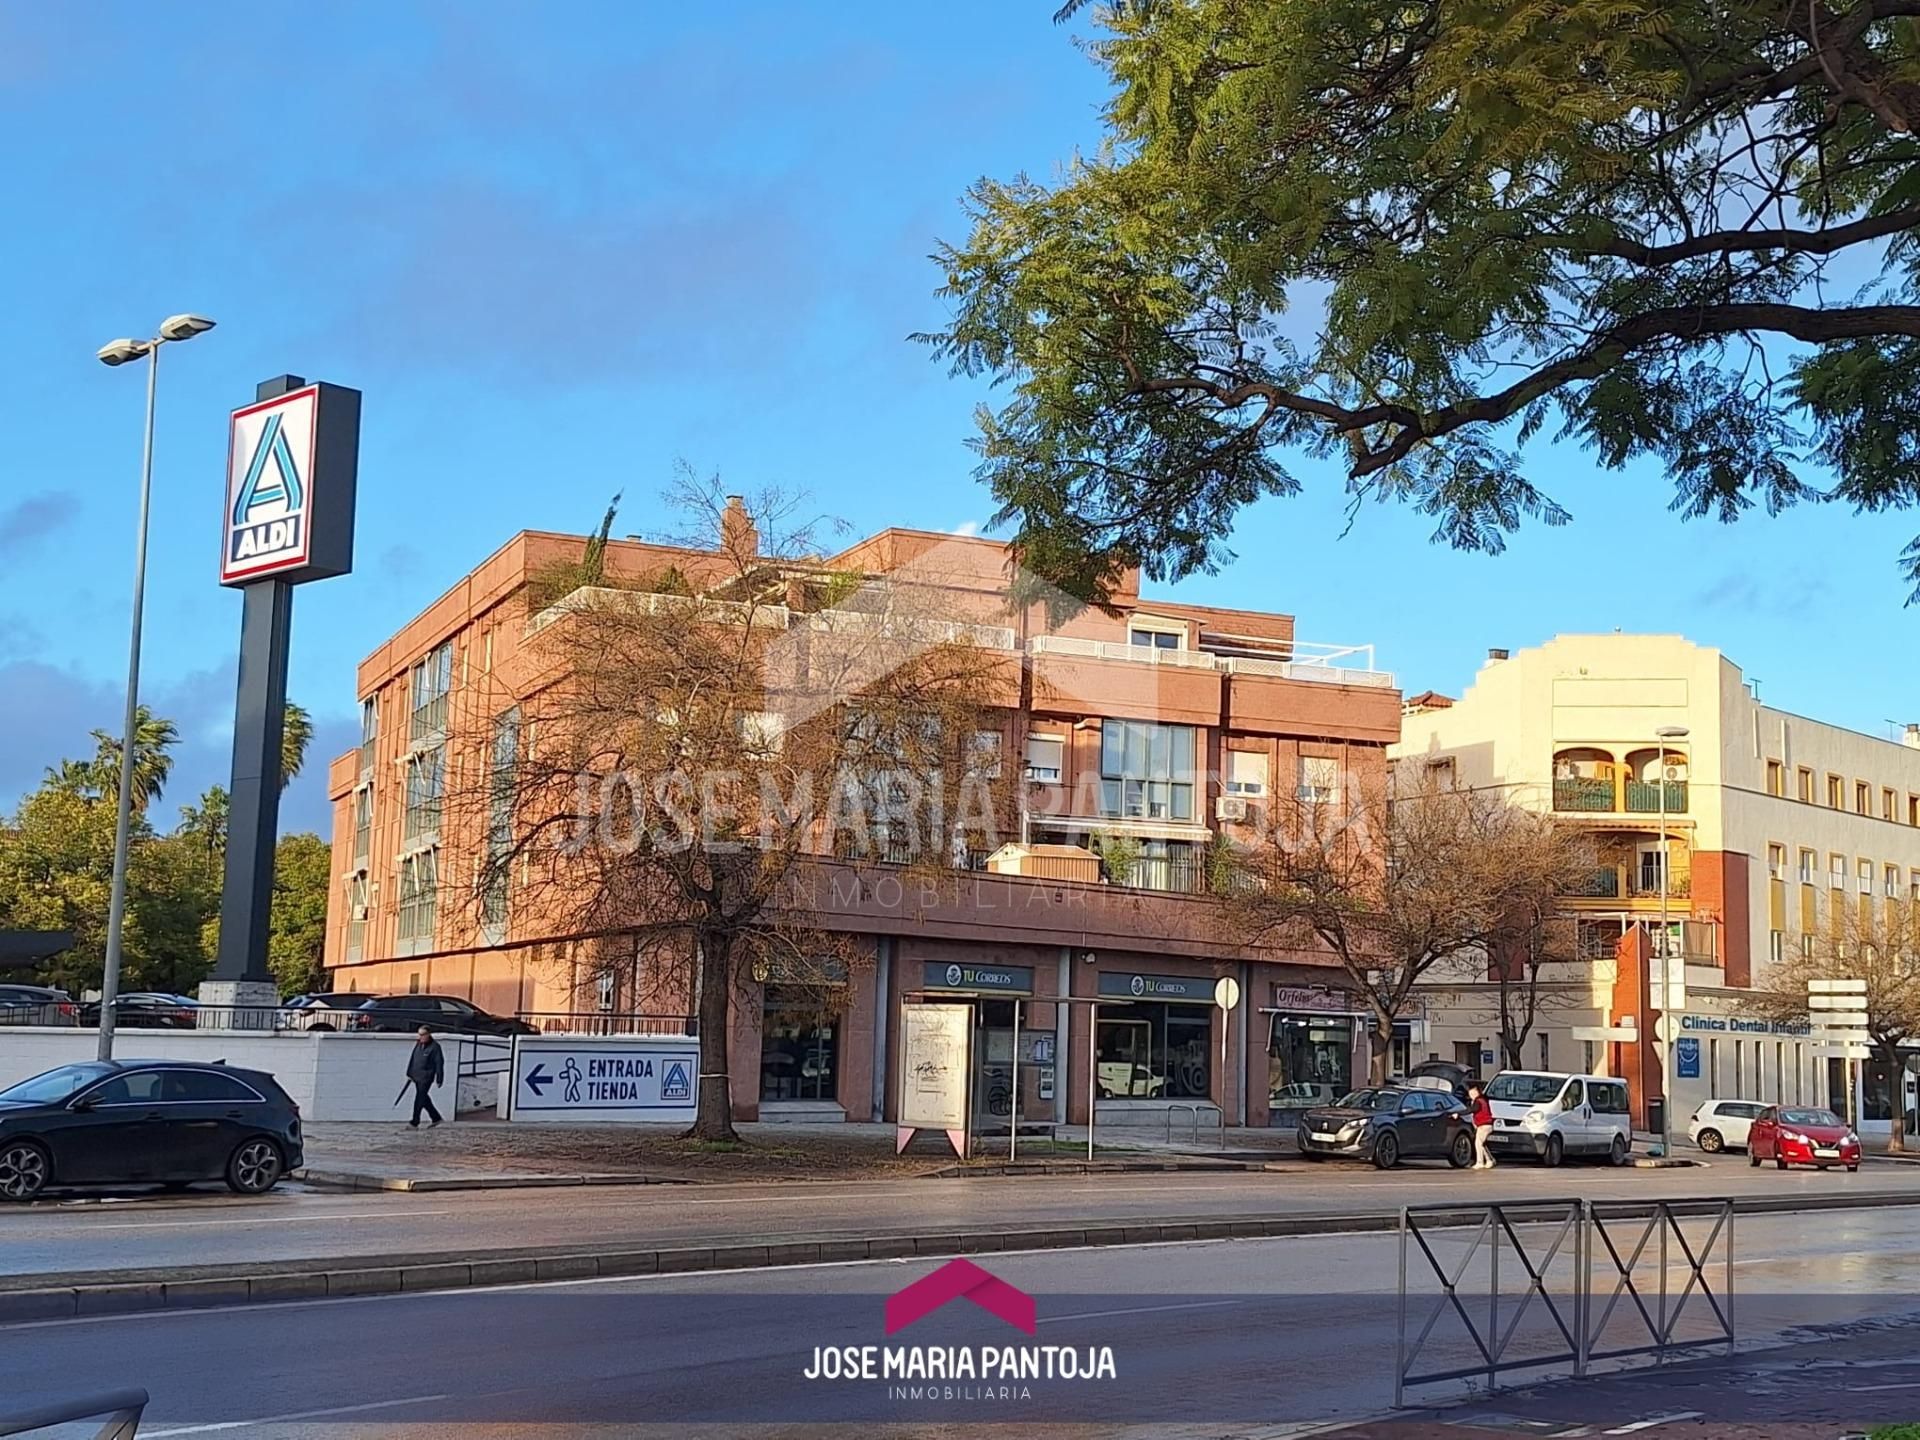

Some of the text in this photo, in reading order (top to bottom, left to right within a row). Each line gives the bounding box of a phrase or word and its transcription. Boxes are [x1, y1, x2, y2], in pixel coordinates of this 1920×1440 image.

[236, 519, 296, 560] ALDI
[963, 969, 975, 983] TU
[1145, 980, 1155, 993] TU
[1730, 1018, 1768, 1033] Dental
[588, 1059, 653, 1078] ENTRADA
[588, 1082, 638, 1101] TIENDA
[665, 1088, 686, 1097] ALDI
